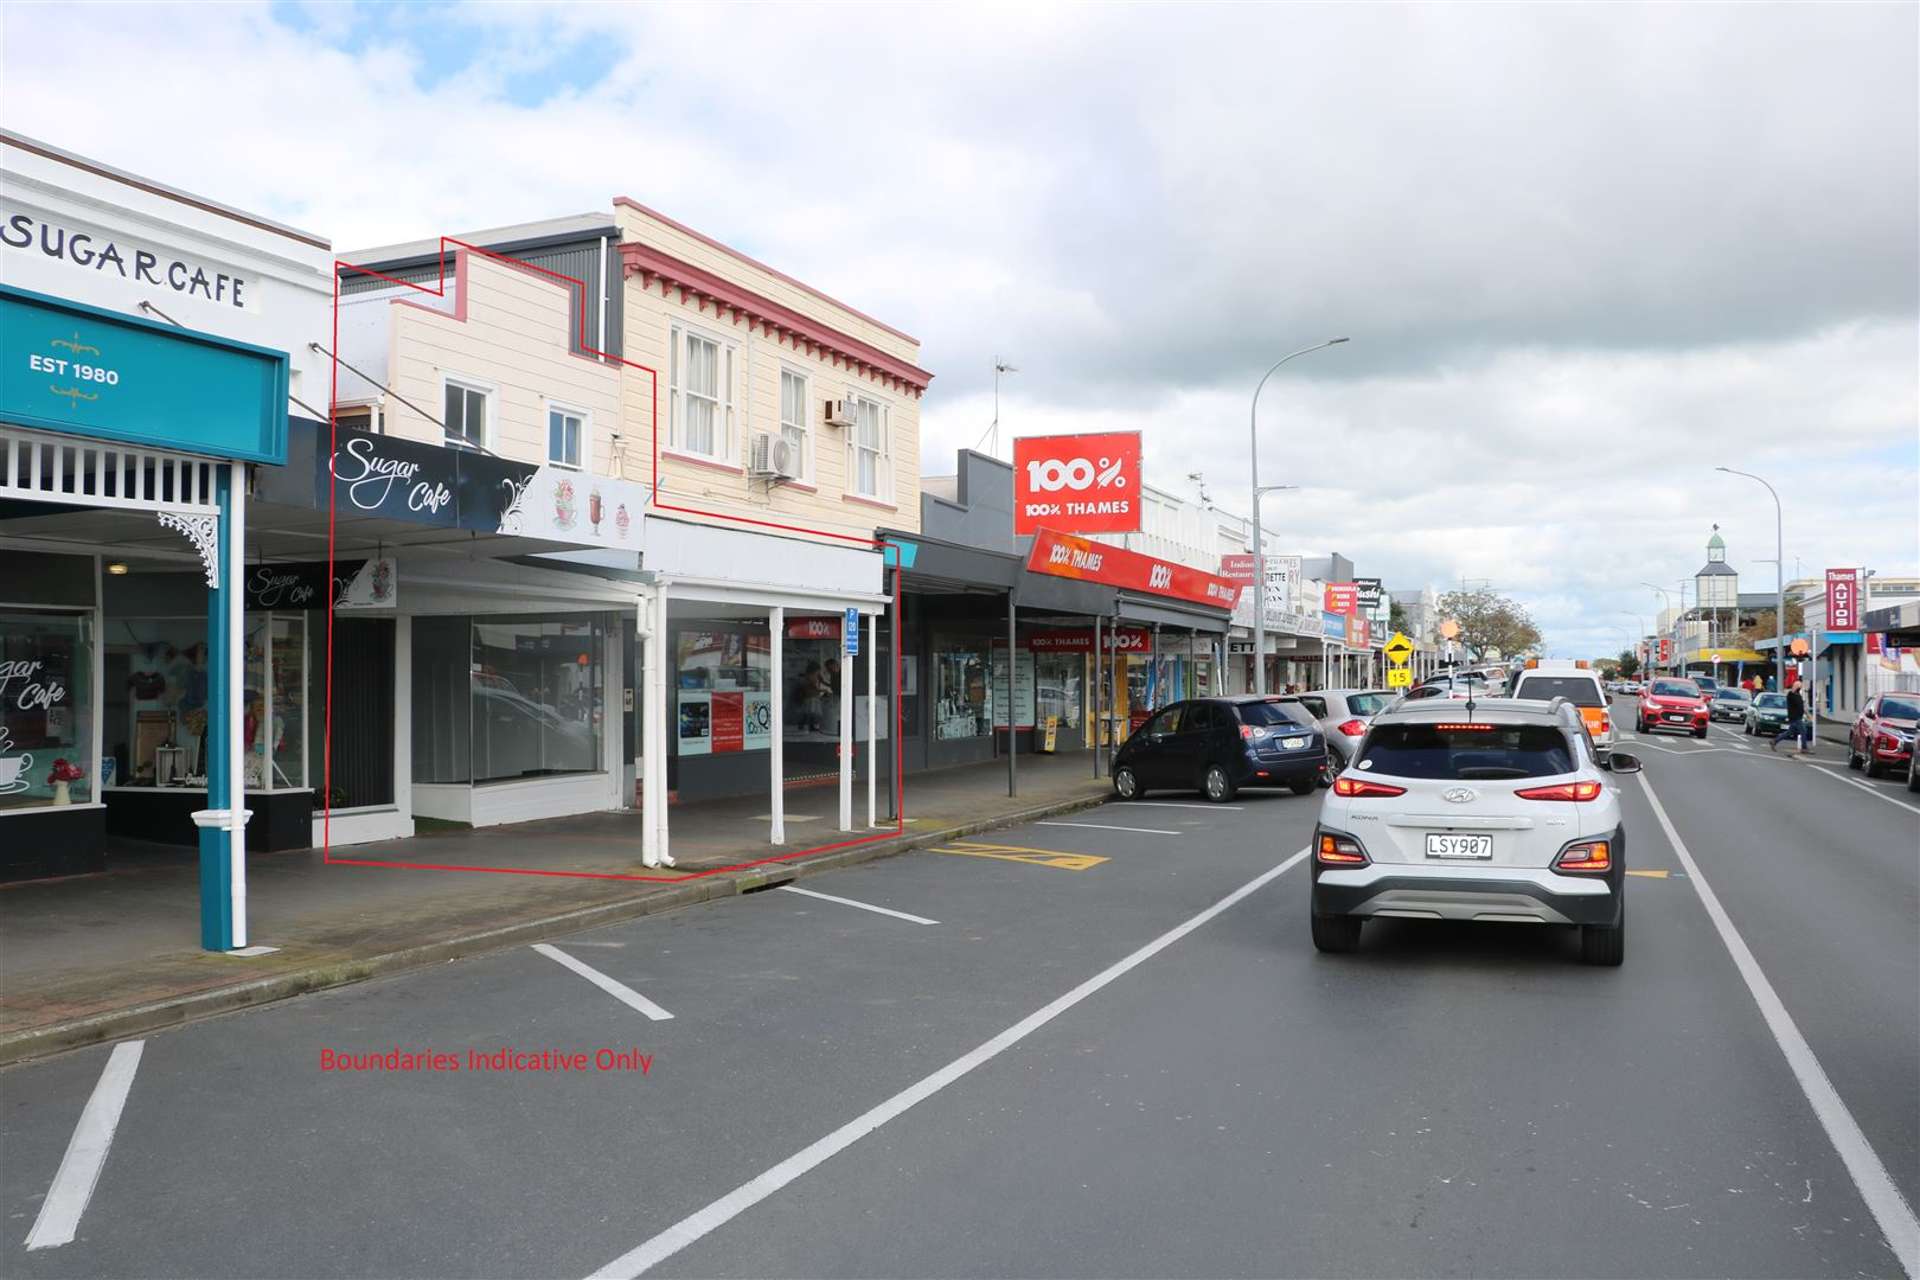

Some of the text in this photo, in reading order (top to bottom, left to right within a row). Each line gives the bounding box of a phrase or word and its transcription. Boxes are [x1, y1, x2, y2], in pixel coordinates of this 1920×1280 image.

[0, 215, 244, 308] SUGAR CAFE
[30, 354, 119, 386] EST 1980
[329, 438, 420, 509] Sugar
[1026, 457, 1126, 493] 100%
[408, 482, 452, 514] Cafe
[1025, 500, 1129, 517] 100% THAMES
[1050, 543, 1103, 572] 100% THAMES
[247, 567, 300, 606] Sugar
[1149, 563, 1173, 590] 100%
[1835, 582, 1848, 627] AUTOS
[1393, 672, 1406, 682] 15
[17, 681, 66, 710] Cafe
[1429, 839, 1489, 854] LSY907
